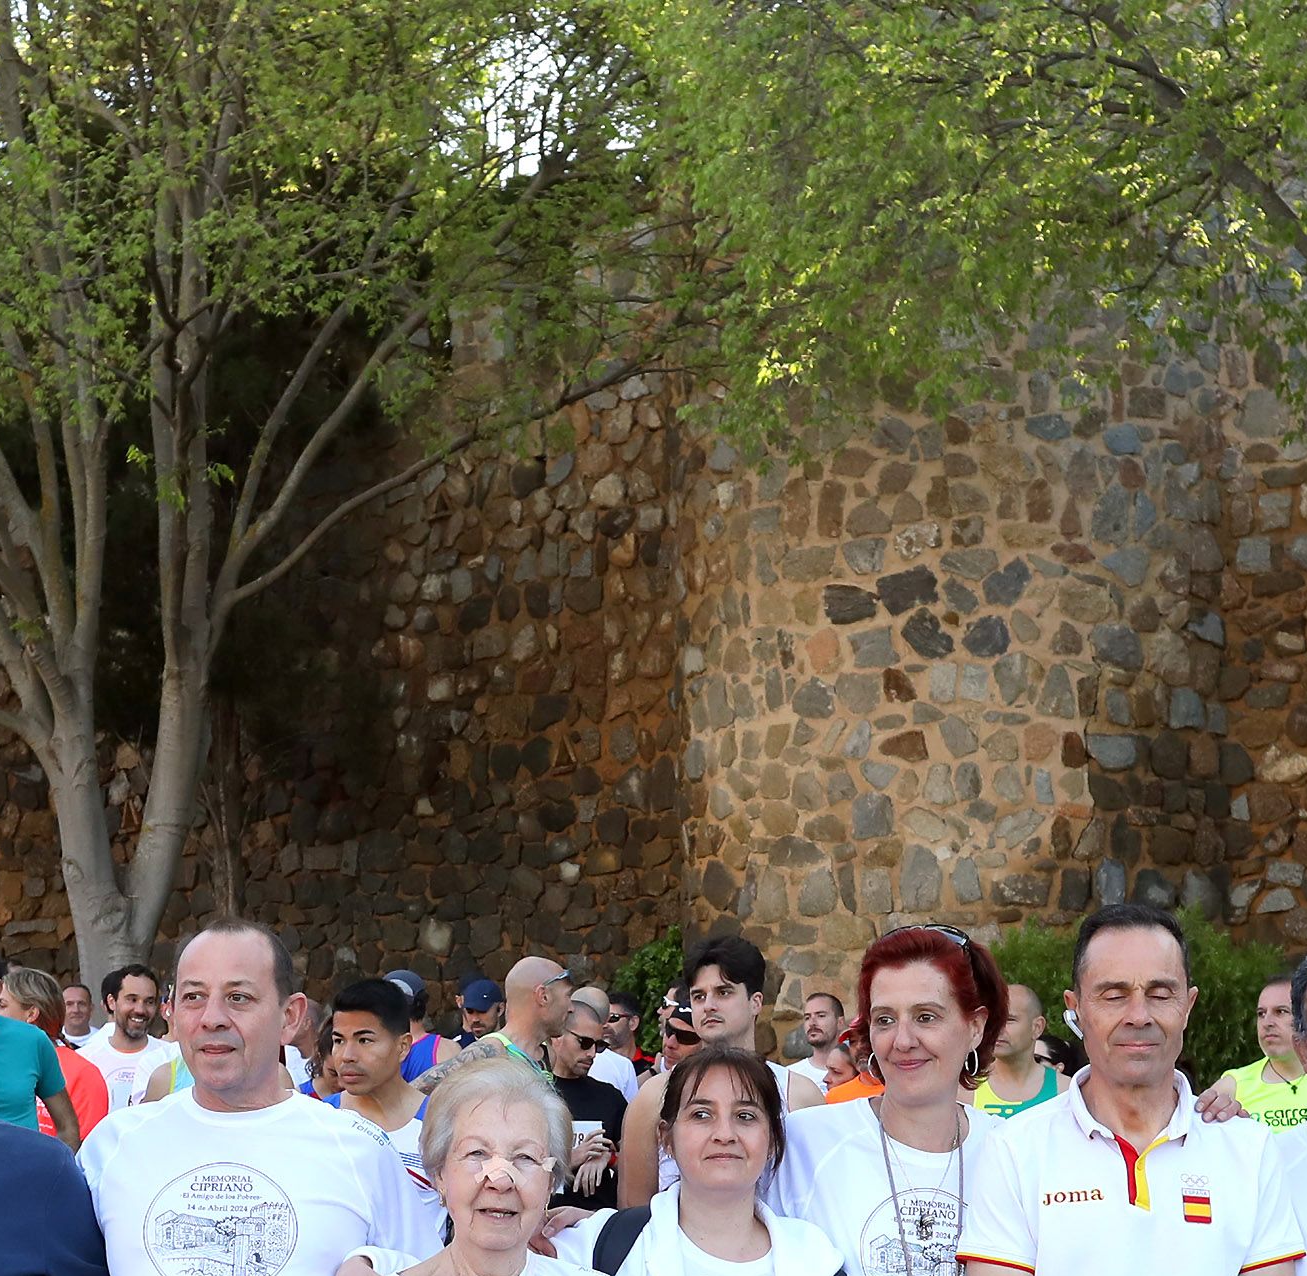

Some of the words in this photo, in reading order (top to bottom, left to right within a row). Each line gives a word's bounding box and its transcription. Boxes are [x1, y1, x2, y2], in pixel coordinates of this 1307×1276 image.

[351, 1120, 385, 1146] Toledo
[202, 1175, 252, 1183] MEMORIAL
[190, 1183, 253, 1192] CIPRIANO
[191, 1193, 214, 1201] Amigo
[910, 1199, 956, 1211] MEMORIAL
